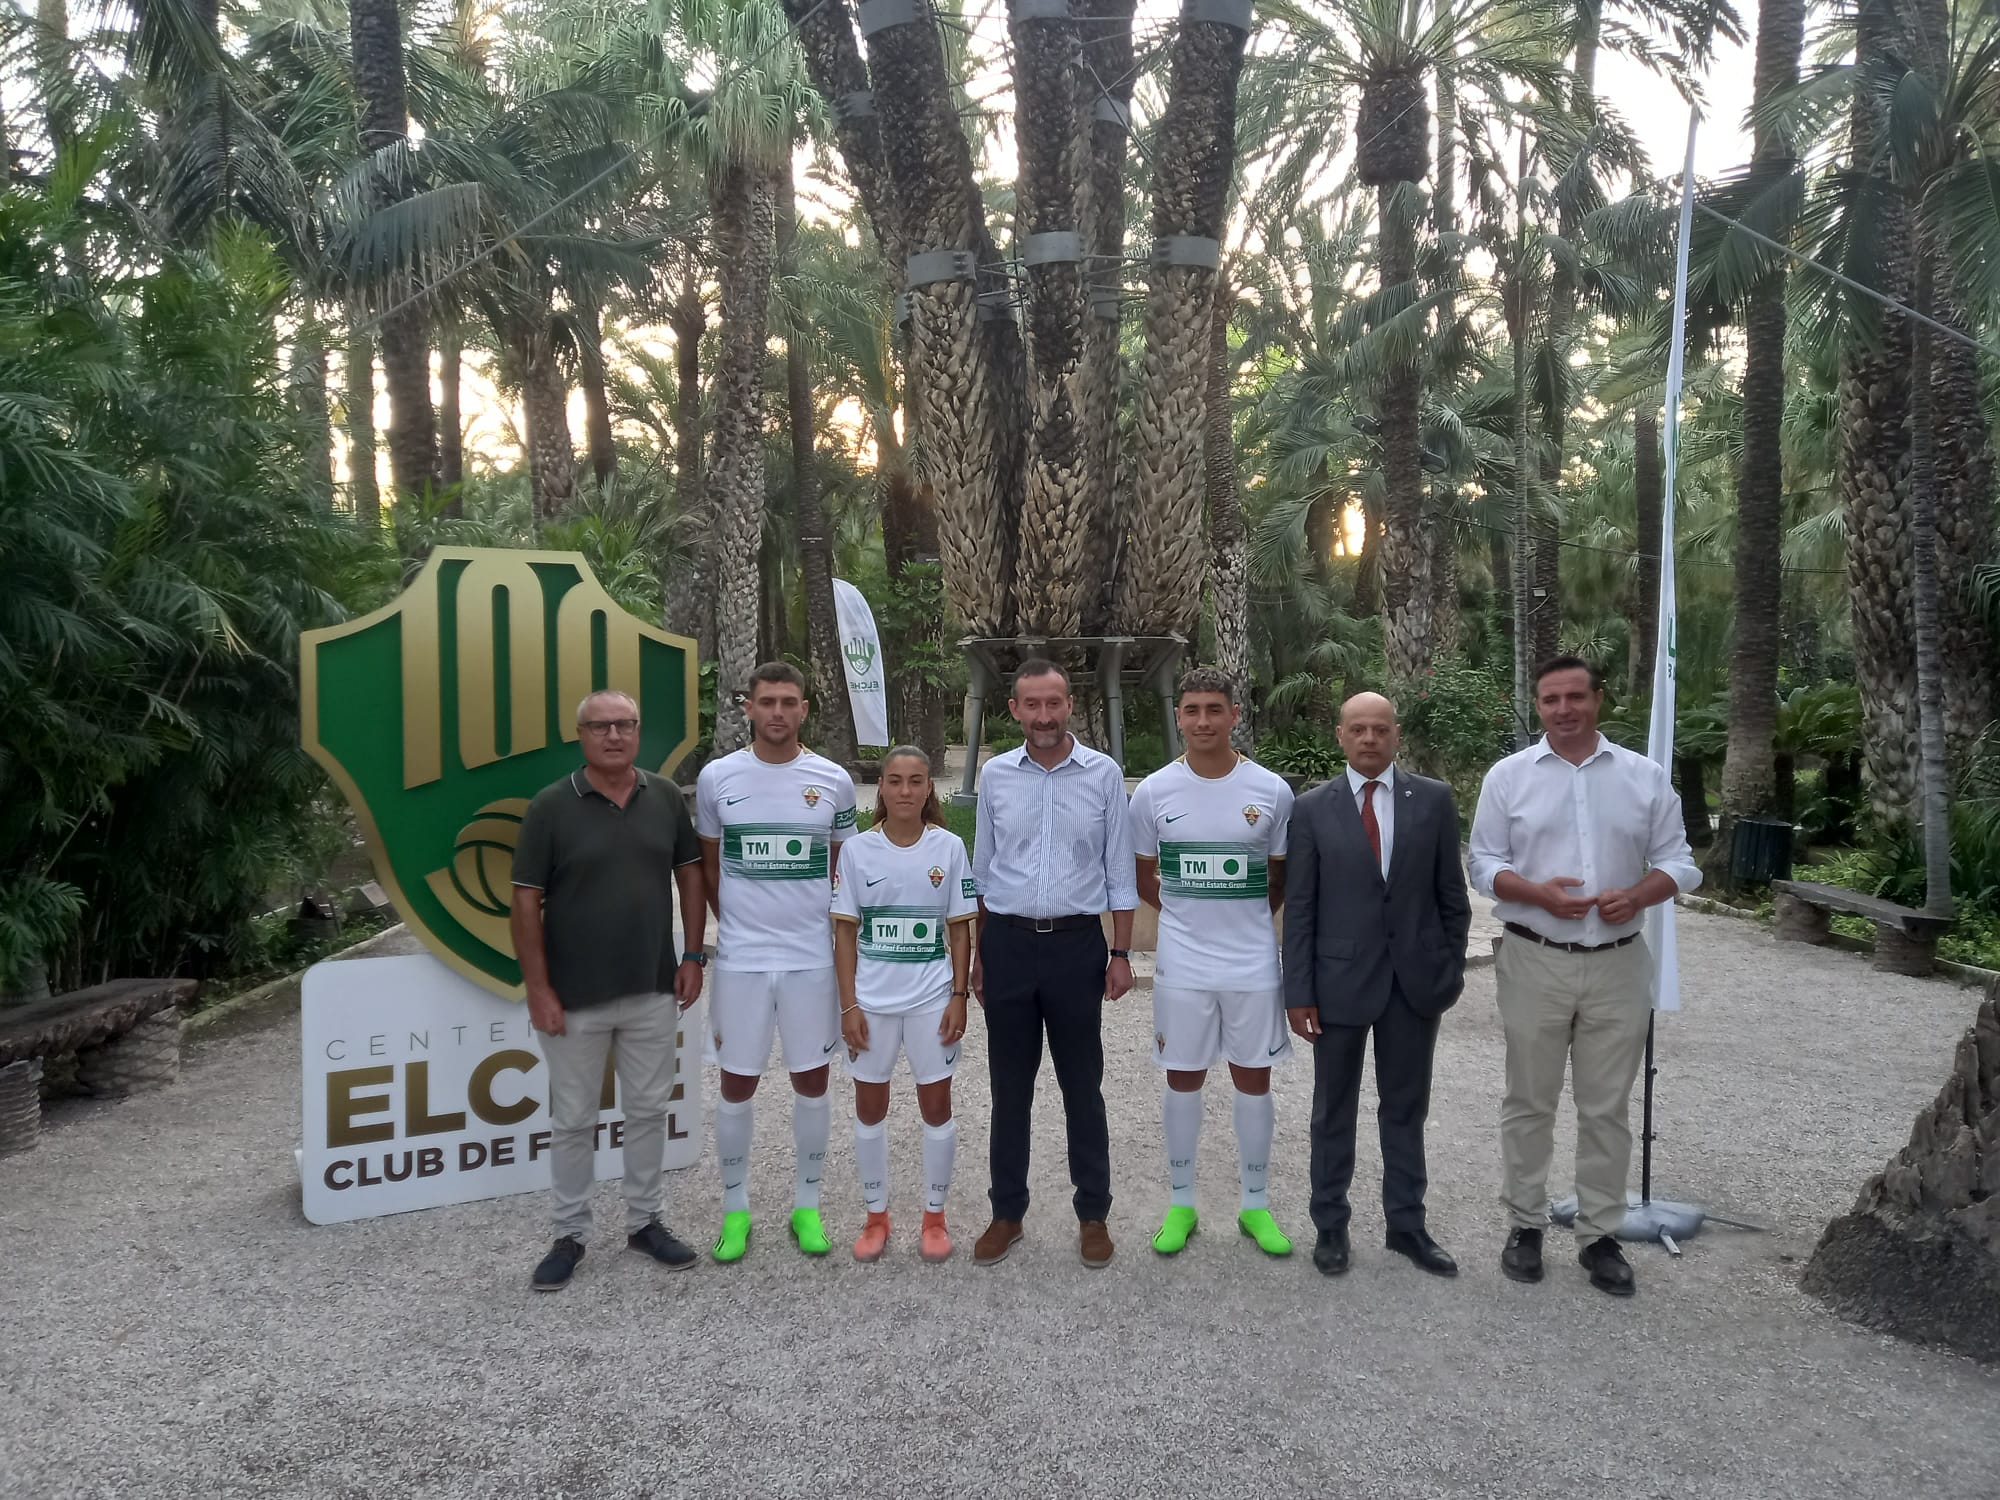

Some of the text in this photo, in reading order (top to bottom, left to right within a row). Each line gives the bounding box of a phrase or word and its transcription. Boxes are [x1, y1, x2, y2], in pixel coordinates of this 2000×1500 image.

[746, 841, 769, 855] TM
[1184, 860, 1206, 874] TM
[1207, 881, 1228, 889] Estate
[877, 924, 898, 938] TM
[324, 1147, 444, 1191] CLUB
[459, 1136, 514, 1172] DE
[864, 1182, 881, 1190] ECF
